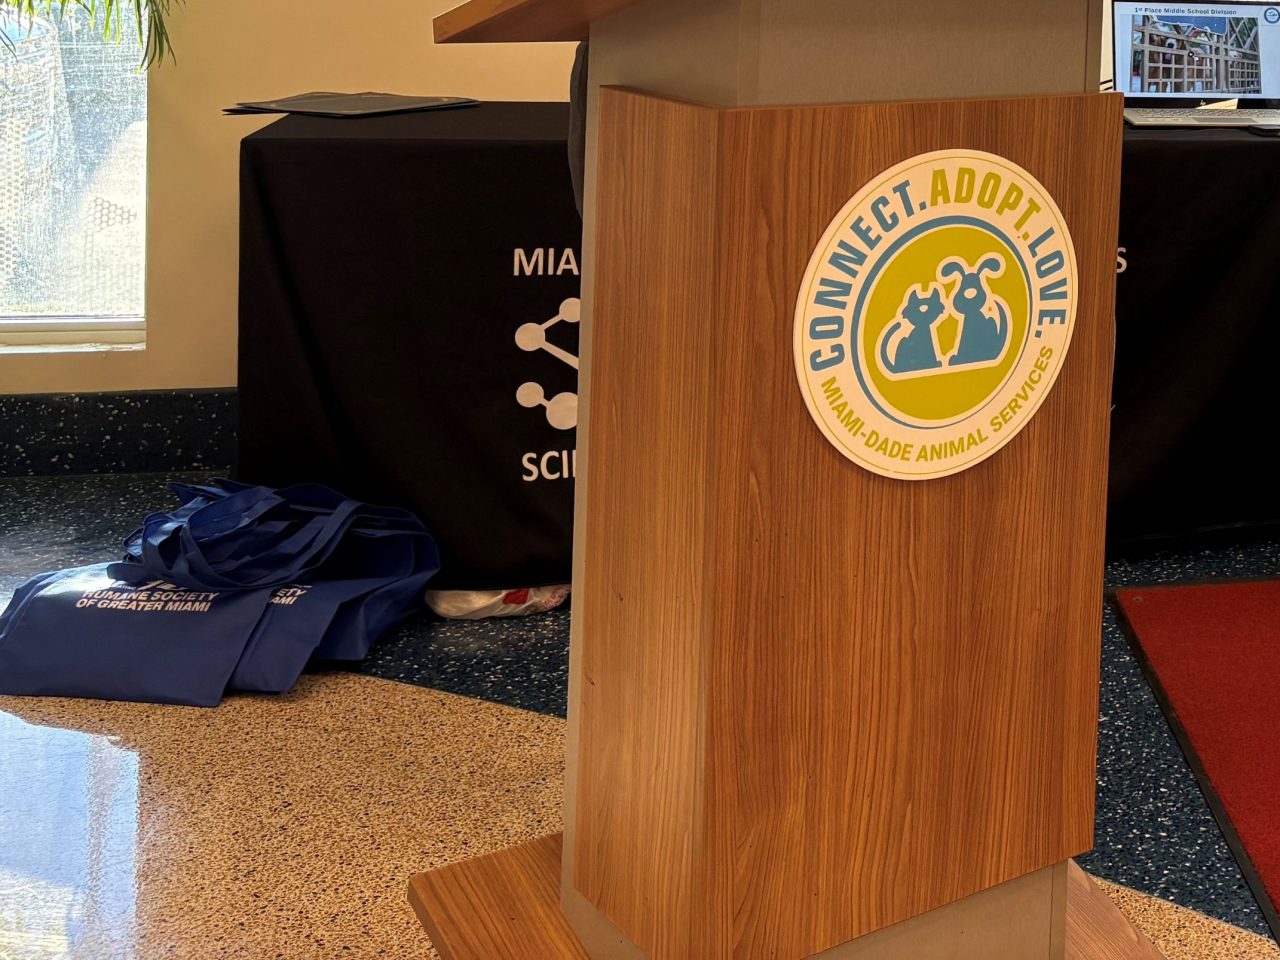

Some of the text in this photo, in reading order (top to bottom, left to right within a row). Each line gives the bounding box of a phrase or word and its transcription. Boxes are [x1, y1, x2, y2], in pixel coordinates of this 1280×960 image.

[820, 344, 1054, 463] MIAMI-DADE ANIMAL SERVICES
[82, 590, 219, 602] HUMANE SOCIETY
[75, 598, 212, 613] OF GREATER MIAMI
